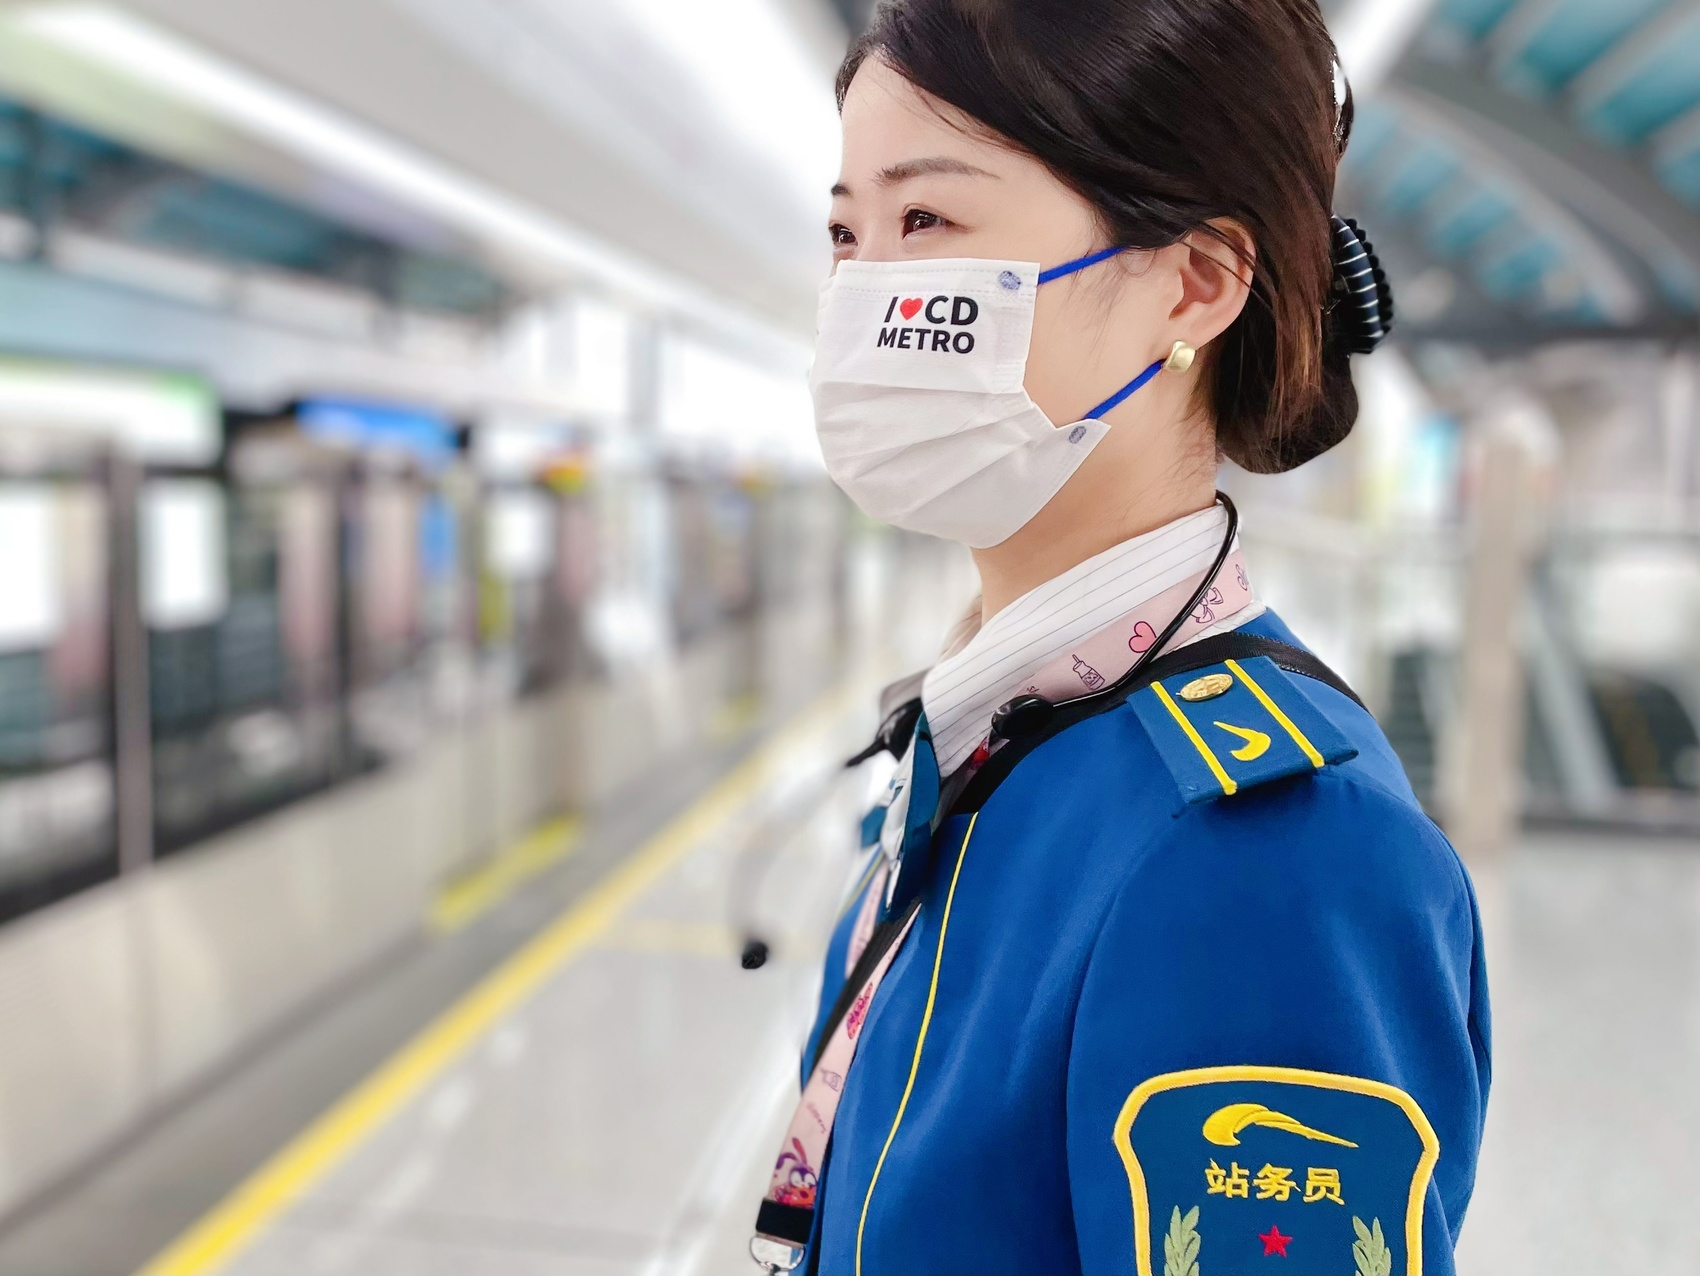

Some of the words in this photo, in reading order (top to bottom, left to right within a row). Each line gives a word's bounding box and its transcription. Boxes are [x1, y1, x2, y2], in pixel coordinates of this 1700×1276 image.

[884, 296, 899, 323] I
[925, 295, 979, 326] CD
[877, 327, 975, 354] METRO
[1204, 1157, 1346, 1206] 站务员
